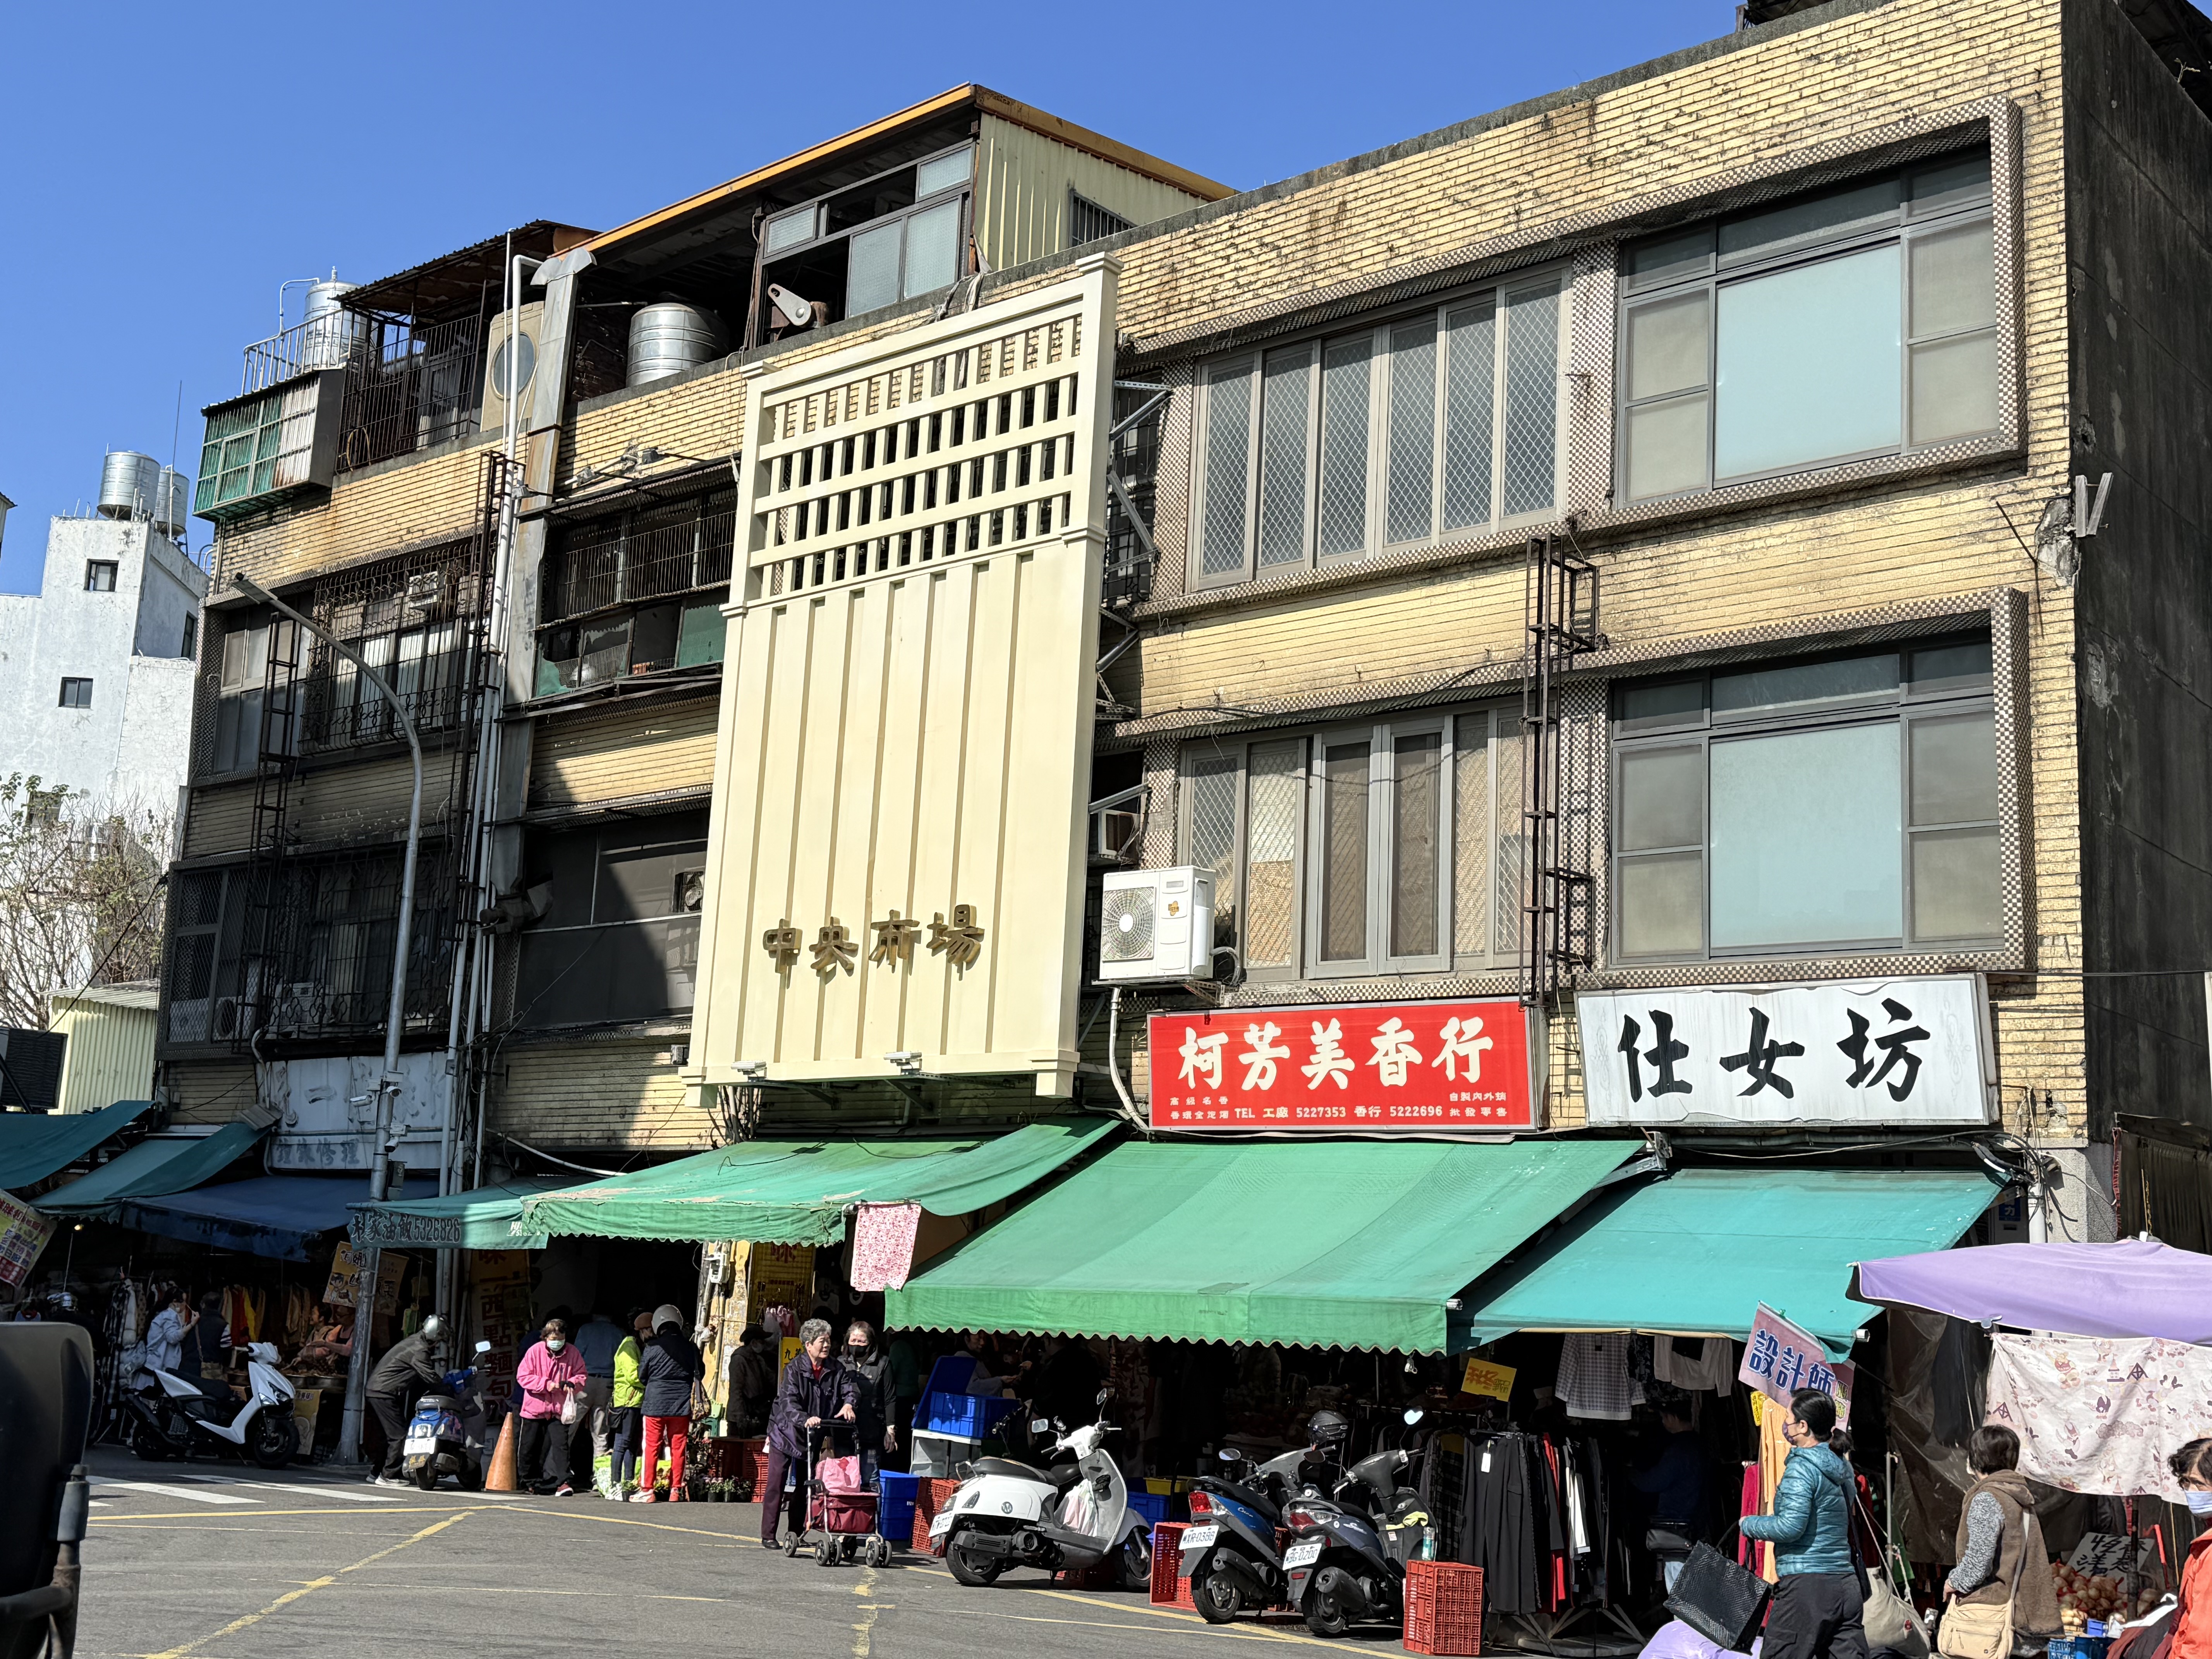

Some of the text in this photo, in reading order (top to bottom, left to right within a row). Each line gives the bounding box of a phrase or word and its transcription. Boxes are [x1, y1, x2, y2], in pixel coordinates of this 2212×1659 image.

[763, 904, 985, 974] 中央市場
[1178, 1017, 1493, 1091] 柯芳美香行
[1618, 998, 1930, 1103] 仕女坊
[1170, 1096, 1228, 1106] 高級名香
[1234, 1108, 1255, 1118] TEL
[1263, 1106, 1288, 1118] 工廠
[1296, 1107, 1346, 1118] 5227353
[1354, 1105, 1381, 1118] 香行
[1390, 1106, 1443, 1116] 5222696
[1748, 1329, 1836, 1396] 設計師
